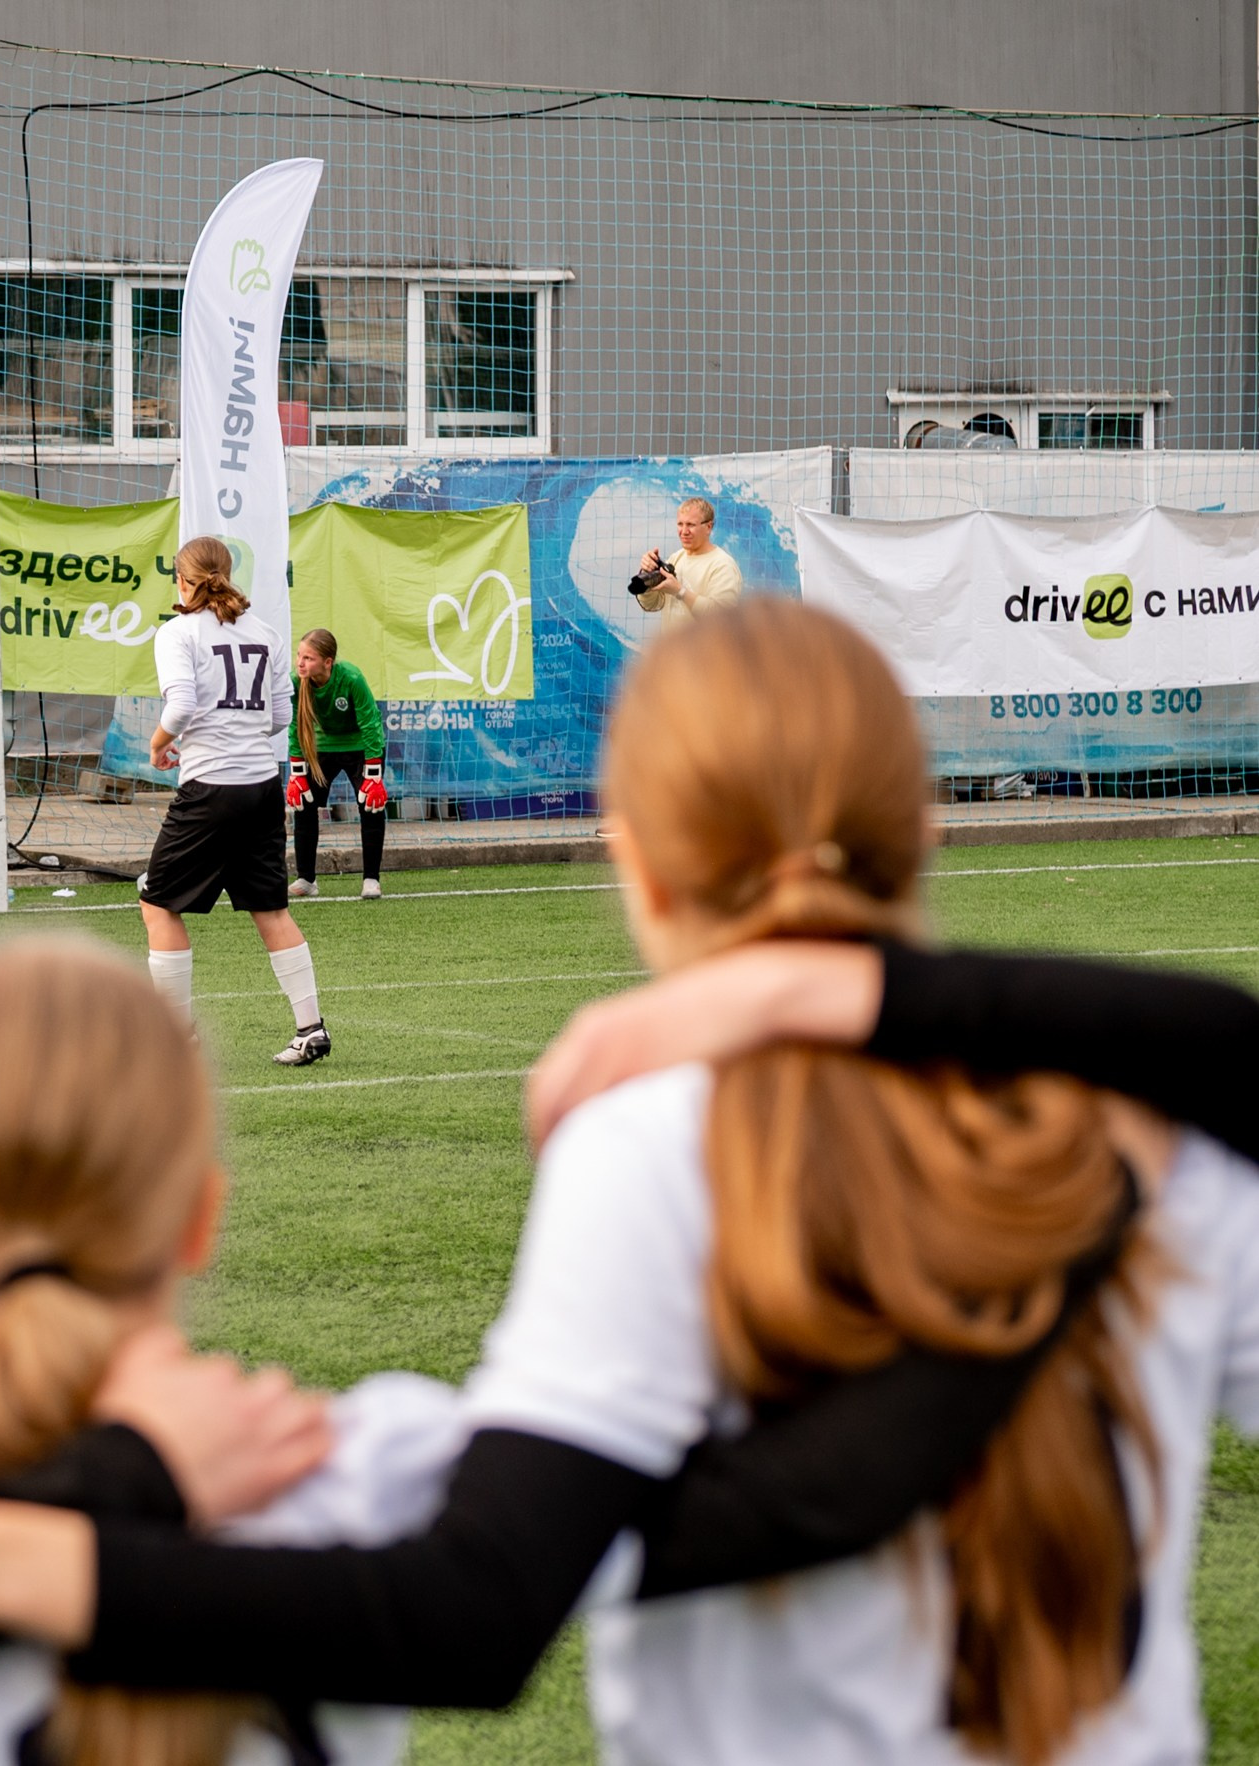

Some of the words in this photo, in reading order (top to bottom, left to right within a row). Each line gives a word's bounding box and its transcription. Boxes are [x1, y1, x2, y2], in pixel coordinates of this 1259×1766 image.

[0, 549, 141, 590] здесь,
[1004, 585, 1132, 627] drivee
[0, 597, 157, 646] drivee
[541, 634, 572, 647] 2024
[212, 644, 269, 711] 17
[485, 711, 515, 720] ГОРОД
[991, 695, 1006, 718] 8
[1012, 693, 1060, 718] 800
[1067, 692, 1118, 717] 300
[1126, 690, 1143, 715] 8
[1152, 688, 1202, 714] 300
[386, 713, 474, 730] СЕЗОНЫ
[485, 720, 514, 728] ОТЕЛЬ
